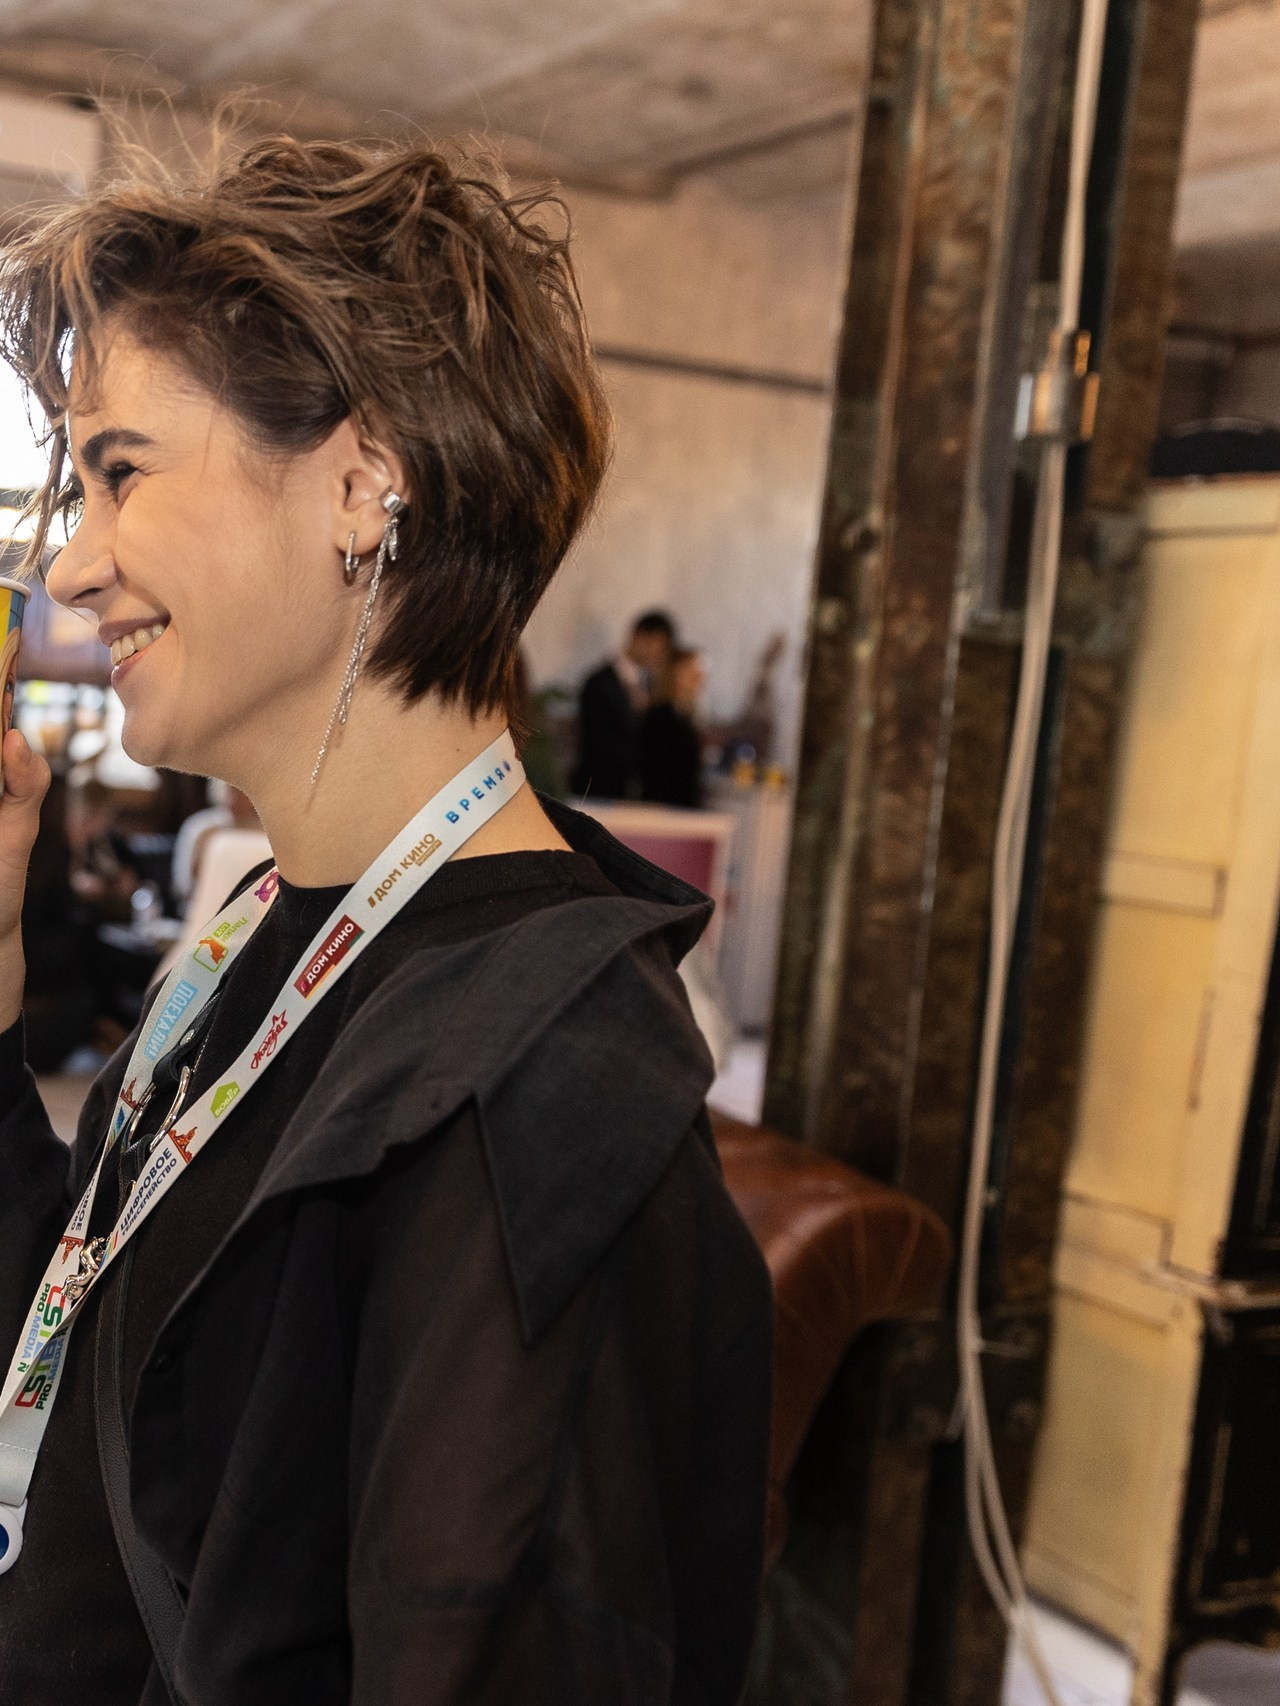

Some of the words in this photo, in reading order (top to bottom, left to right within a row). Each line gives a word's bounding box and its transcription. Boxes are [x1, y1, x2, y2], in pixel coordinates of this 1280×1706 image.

[445, 767, 505, 824] ВРЕМЯ
[374, 868, 403, 901] ДОМ
[400, 833, 436, 870] КИНО
[306, 955, 329, 984] ДОМ
[326, 922, 355, 956] КИНО
[146, 982, 194, 1058] ПОЕХАЛИ!
[120, 1147, 173, 1231] ЦИФРОВОЕ
[121, 1157, 178, 1236] ТЕЛЕСЕМЕЙСТВО
